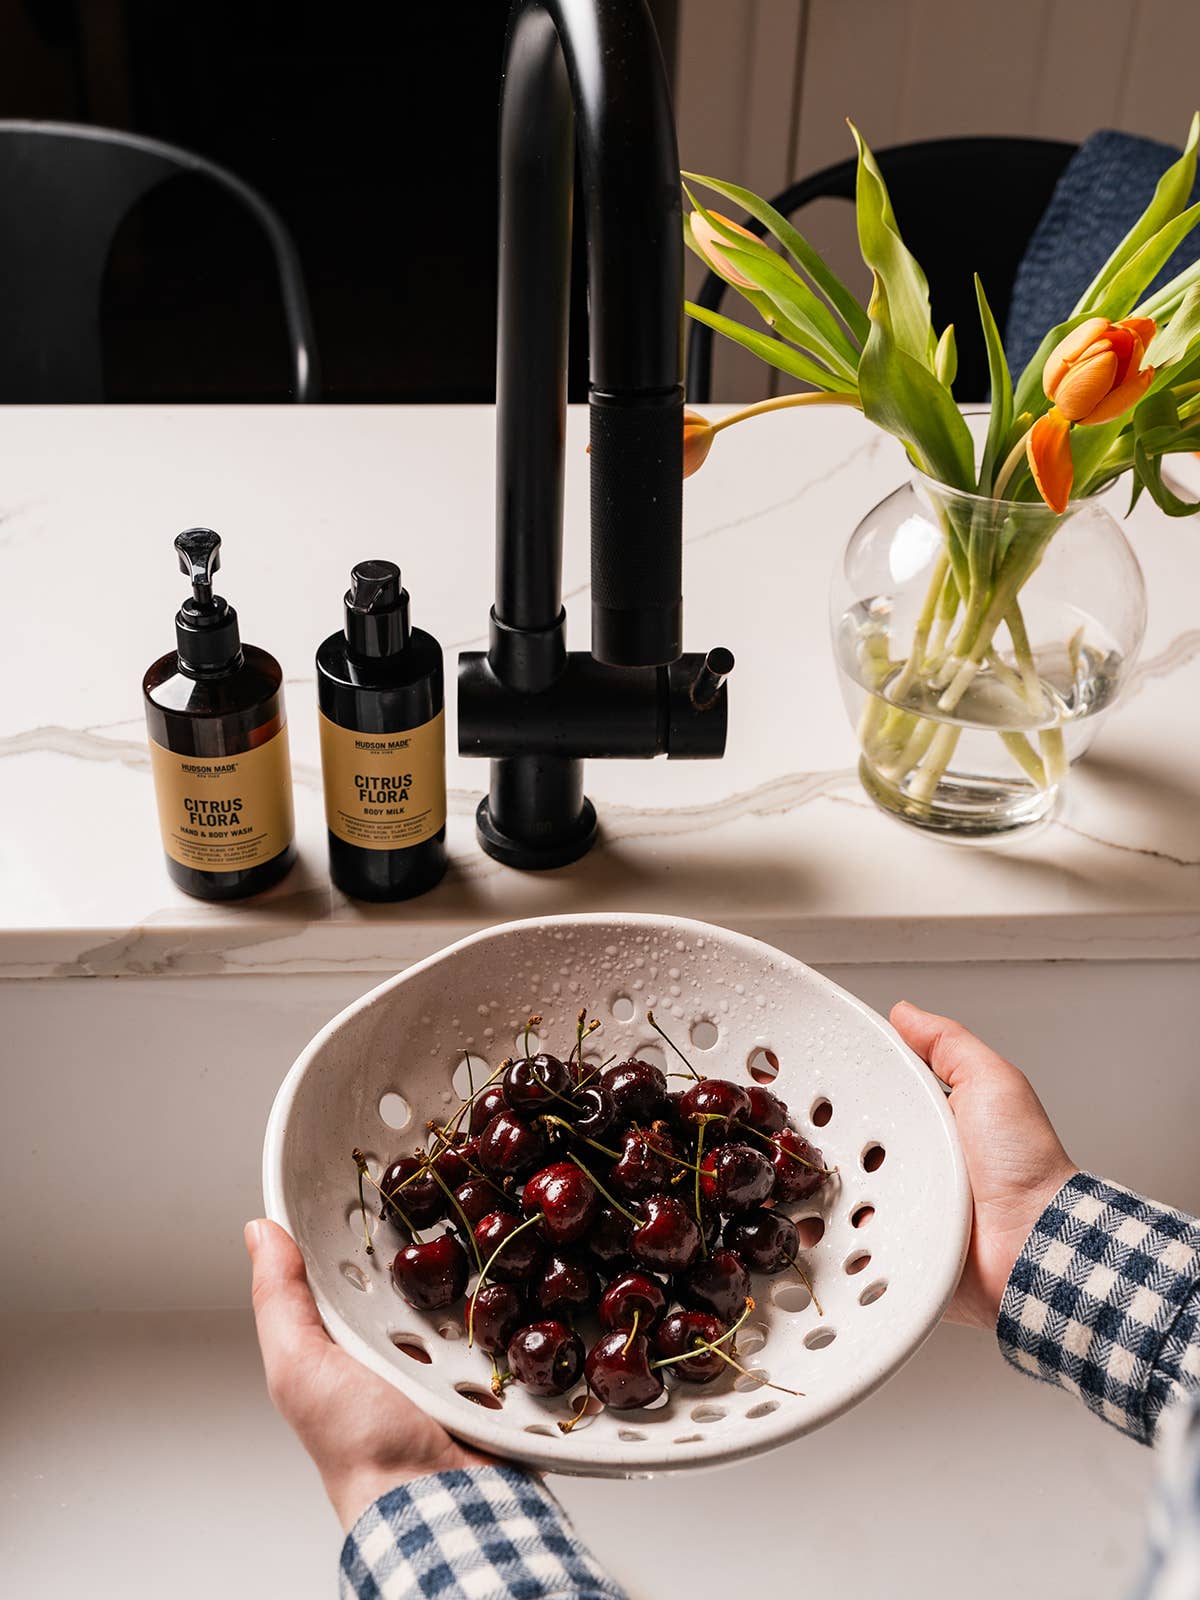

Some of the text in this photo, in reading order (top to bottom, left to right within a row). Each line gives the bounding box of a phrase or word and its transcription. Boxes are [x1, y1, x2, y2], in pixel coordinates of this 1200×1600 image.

[355, 740, 386, 749] HUDSON
[181, 763, 212, 773] HUDSON
[354, 774, 413, 790] CITRUS
[360, 789, 409, 803] FLORA
[184, 798, 243, 813] CITRUS
[364, 807, 405, 816] BODY MILK
[190, 812, 240, 827] FLORA
[180, 826, 199, 837] HAND
[230, 826, 253, 837] WASH
